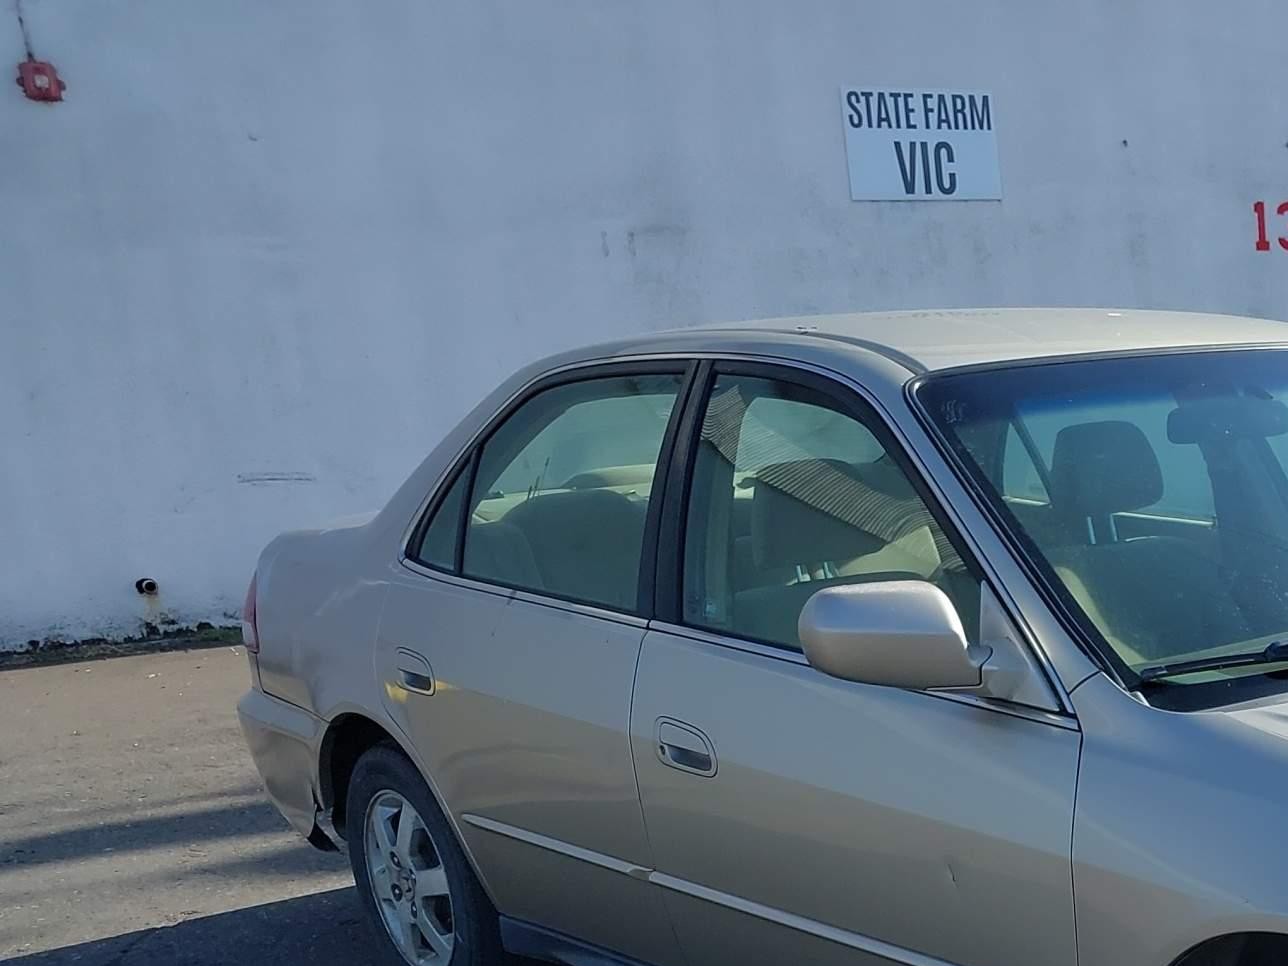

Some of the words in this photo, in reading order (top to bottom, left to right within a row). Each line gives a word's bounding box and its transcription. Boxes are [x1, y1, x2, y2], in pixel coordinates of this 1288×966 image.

[846, 91, 917, 129] STATE
[922, 93, 992, 131] FARM
[893, 141, 957, 195] VIC
